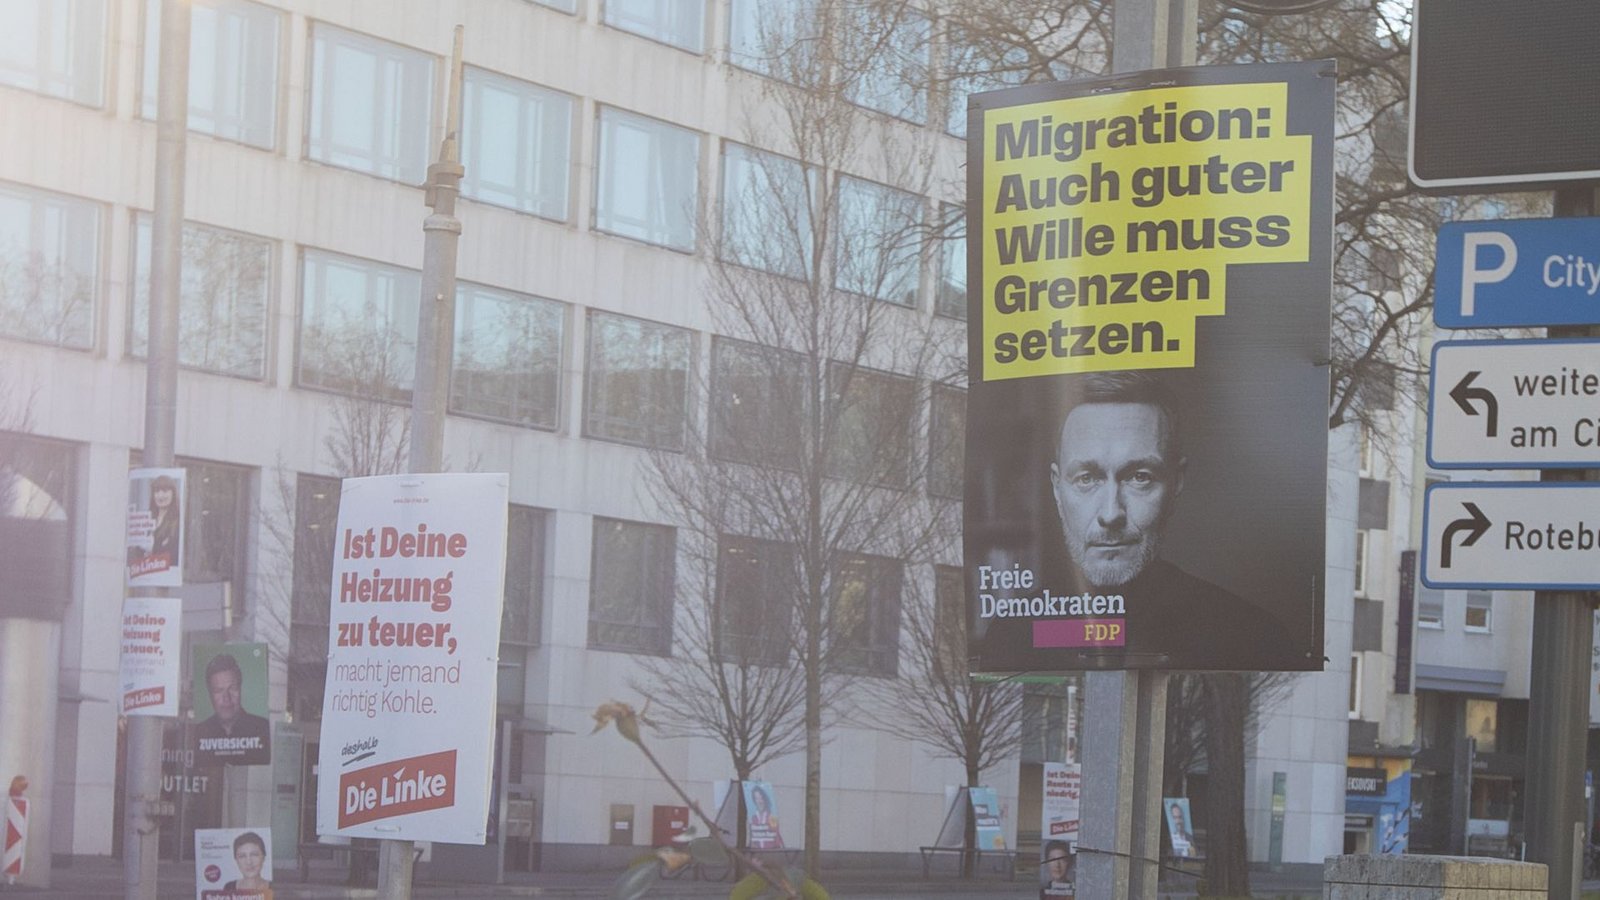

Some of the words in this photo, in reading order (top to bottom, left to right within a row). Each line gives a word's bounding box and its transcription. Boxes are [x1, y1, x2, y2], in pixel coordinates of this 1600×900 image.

[995, 102, 1271, 162] Migration:
[994, 162, 1120, 214] Auch
[1131, 155, 1295, 208] guter
[995, 217, 1115, 266] Wille
[1126, 214, 1291, 254] muss
[1460, 231, 1518, 317] P
[1543, 254, 1600, 295] City
[994, 267, 1210, 315] Grenzen
[994, 315, 1180, 364] setzen.
[1510, 426, 1557, 448] am
[343, 528, 376, 560] Ist
[379, 523, 467, 558] Deine
[1505, 520, 1600, 550] Roteb
[340, 568, 453, 612] Heizung
[979, 563, 1033, 590] Freie
[980, 590, 1126, 618] Demokraten
[337, 622, 364, 647] zu
[368, 615, 457, 655] teuer,
[1084, 624, 1121, 641] FDP
[334, 658, 382, 682] macht
[383, 660, 461, 688] jemand
[332, 690, 378, 718] richtig
[381, 690, 437, 714] Kohle.
[199, 736, 263, 751] ZUVERSICHT.
[341, 736, 378, 756] deshalb
[160, 775, 208, 793] UTLET
[345, 781, 377, 815] Die
[380, 766, 447, 807] Linke
